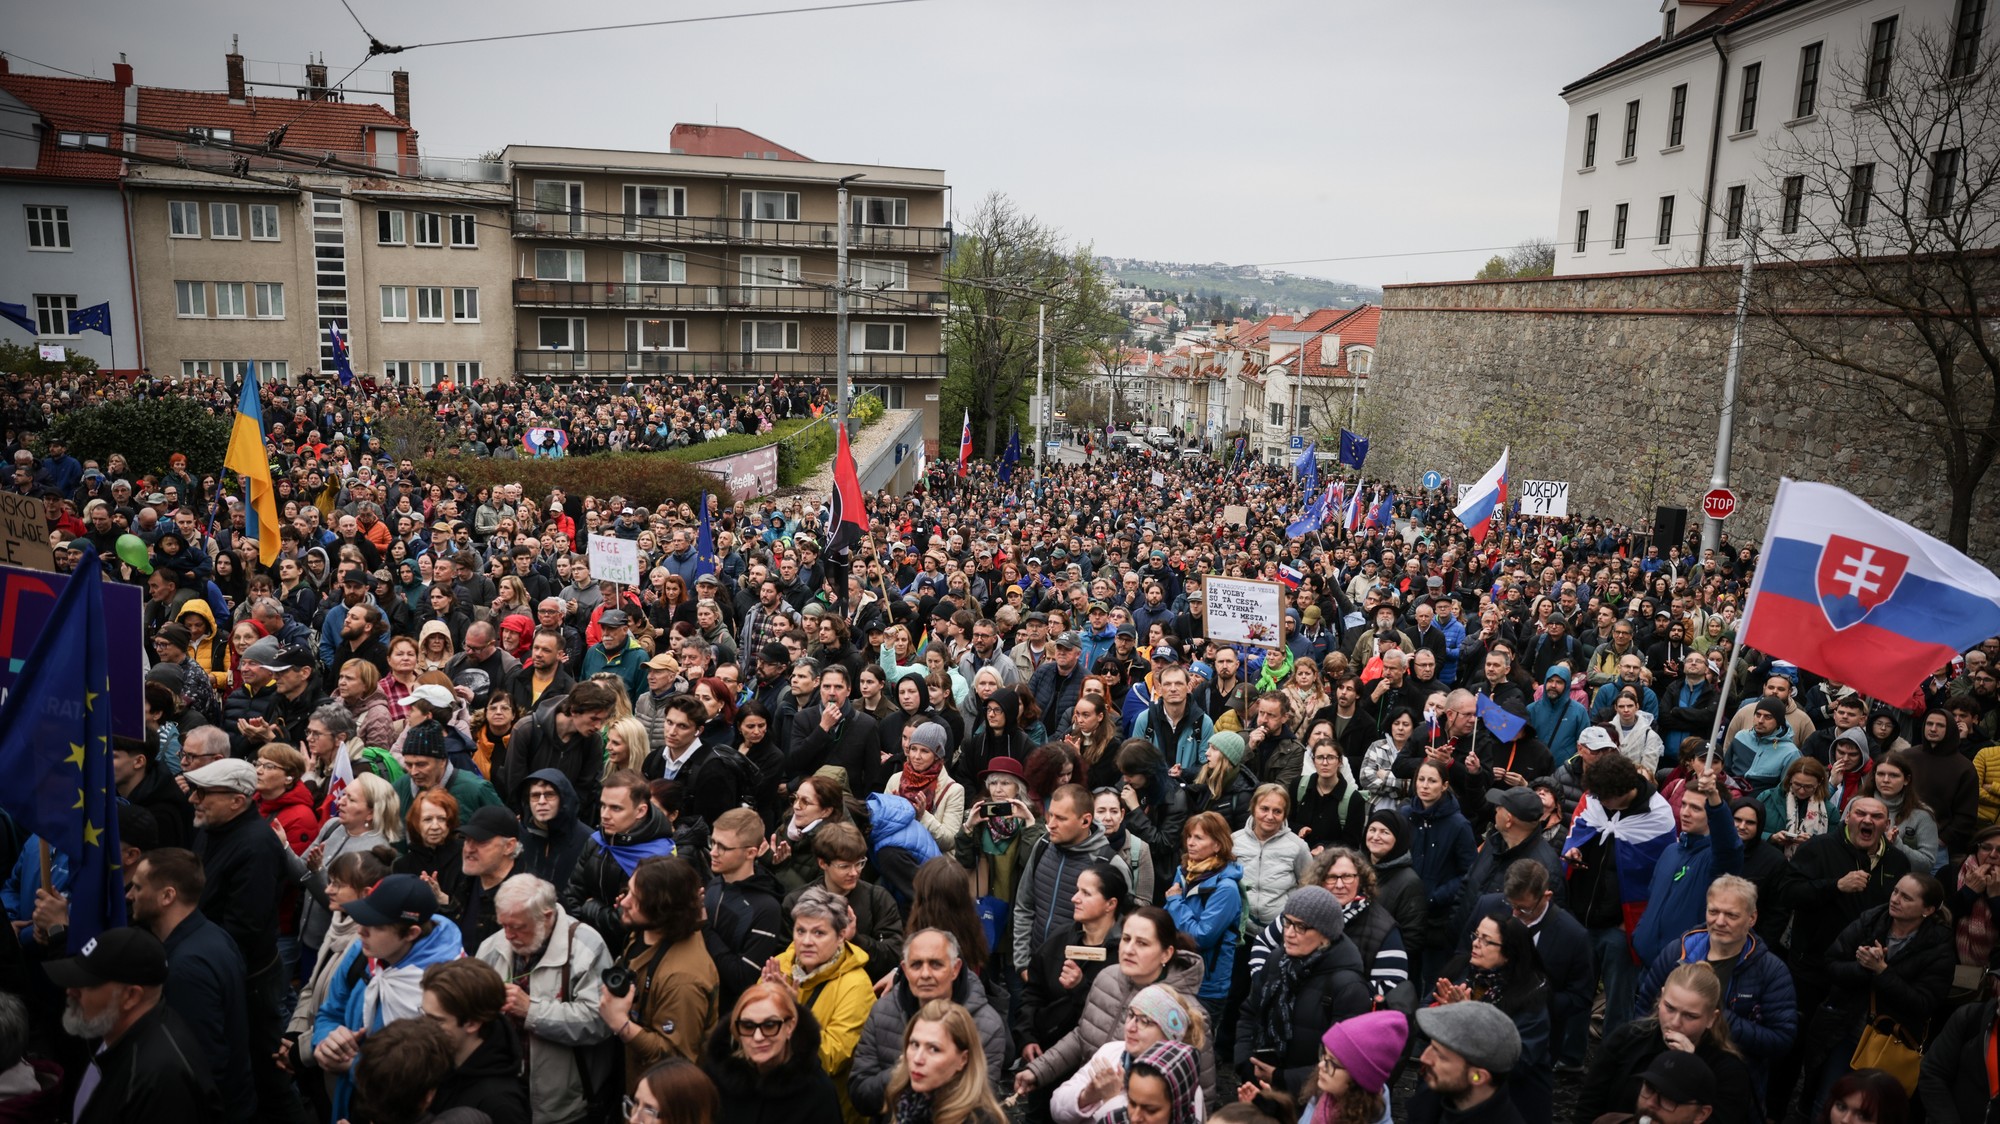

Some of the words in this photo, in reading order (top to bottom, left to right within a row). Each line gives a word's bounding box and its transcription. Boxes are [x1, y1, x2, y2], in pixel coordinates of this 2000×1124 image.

[1523, 481, 1568, 498] DOKEDY
[1705, 497, 1733, 510] STOP
[1235, 598, 1262, 607] CESTA,
[1209, 609, 1228, 617] FICA
[1240, 613, 1267, 622] MESTA!
